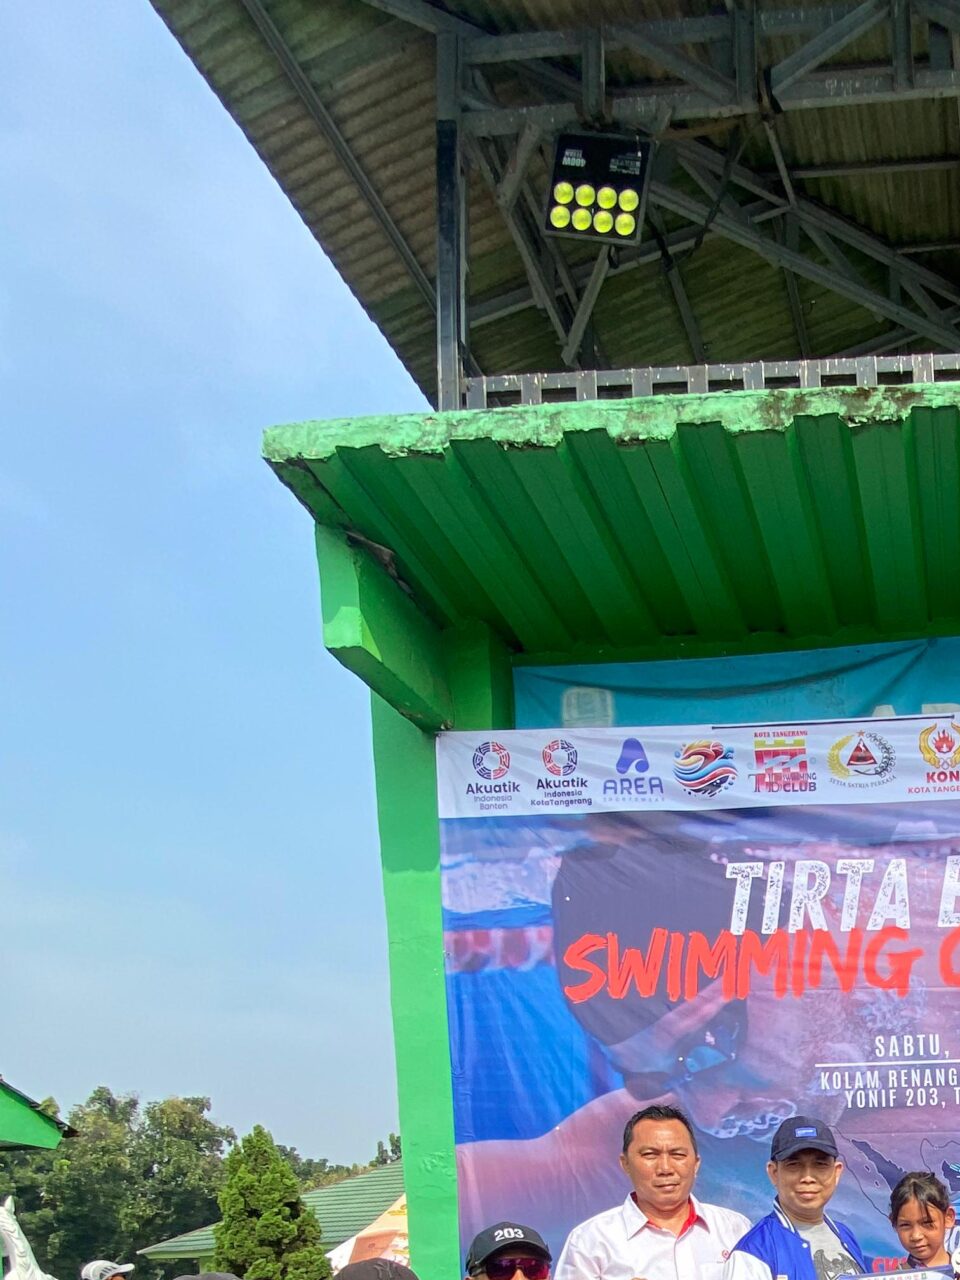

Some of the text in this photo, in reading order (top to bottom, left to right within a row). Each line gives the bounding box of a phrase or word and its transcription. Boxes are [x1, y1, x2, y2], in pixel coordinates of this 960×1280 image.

[466, 781, 520, 794] Akuatik
[536, 777, 588, 790] Akuatik
[603, 777, 664, 795] AREA
[783, 781, 817, 793] CLUB
[829, 777, 846, 787] SETIA
[474, 794, 513, 803] Indonesia
[544, 789, 583, 798] Indonesia
[725, 858, 911, 935] TIRTA
[563, 927, 924, 1004] SWIMMING
[875, 1033, 950, 1059] SABTU,
[820, 1070, 879, 1090] KOLAM
[888, 1067, 958, 1088] RENANG
[845, 1089, 897, 1109] YONIF
[906, 1087, 946, 1109] 203,
[494, 1227, 525, 1241] 203
